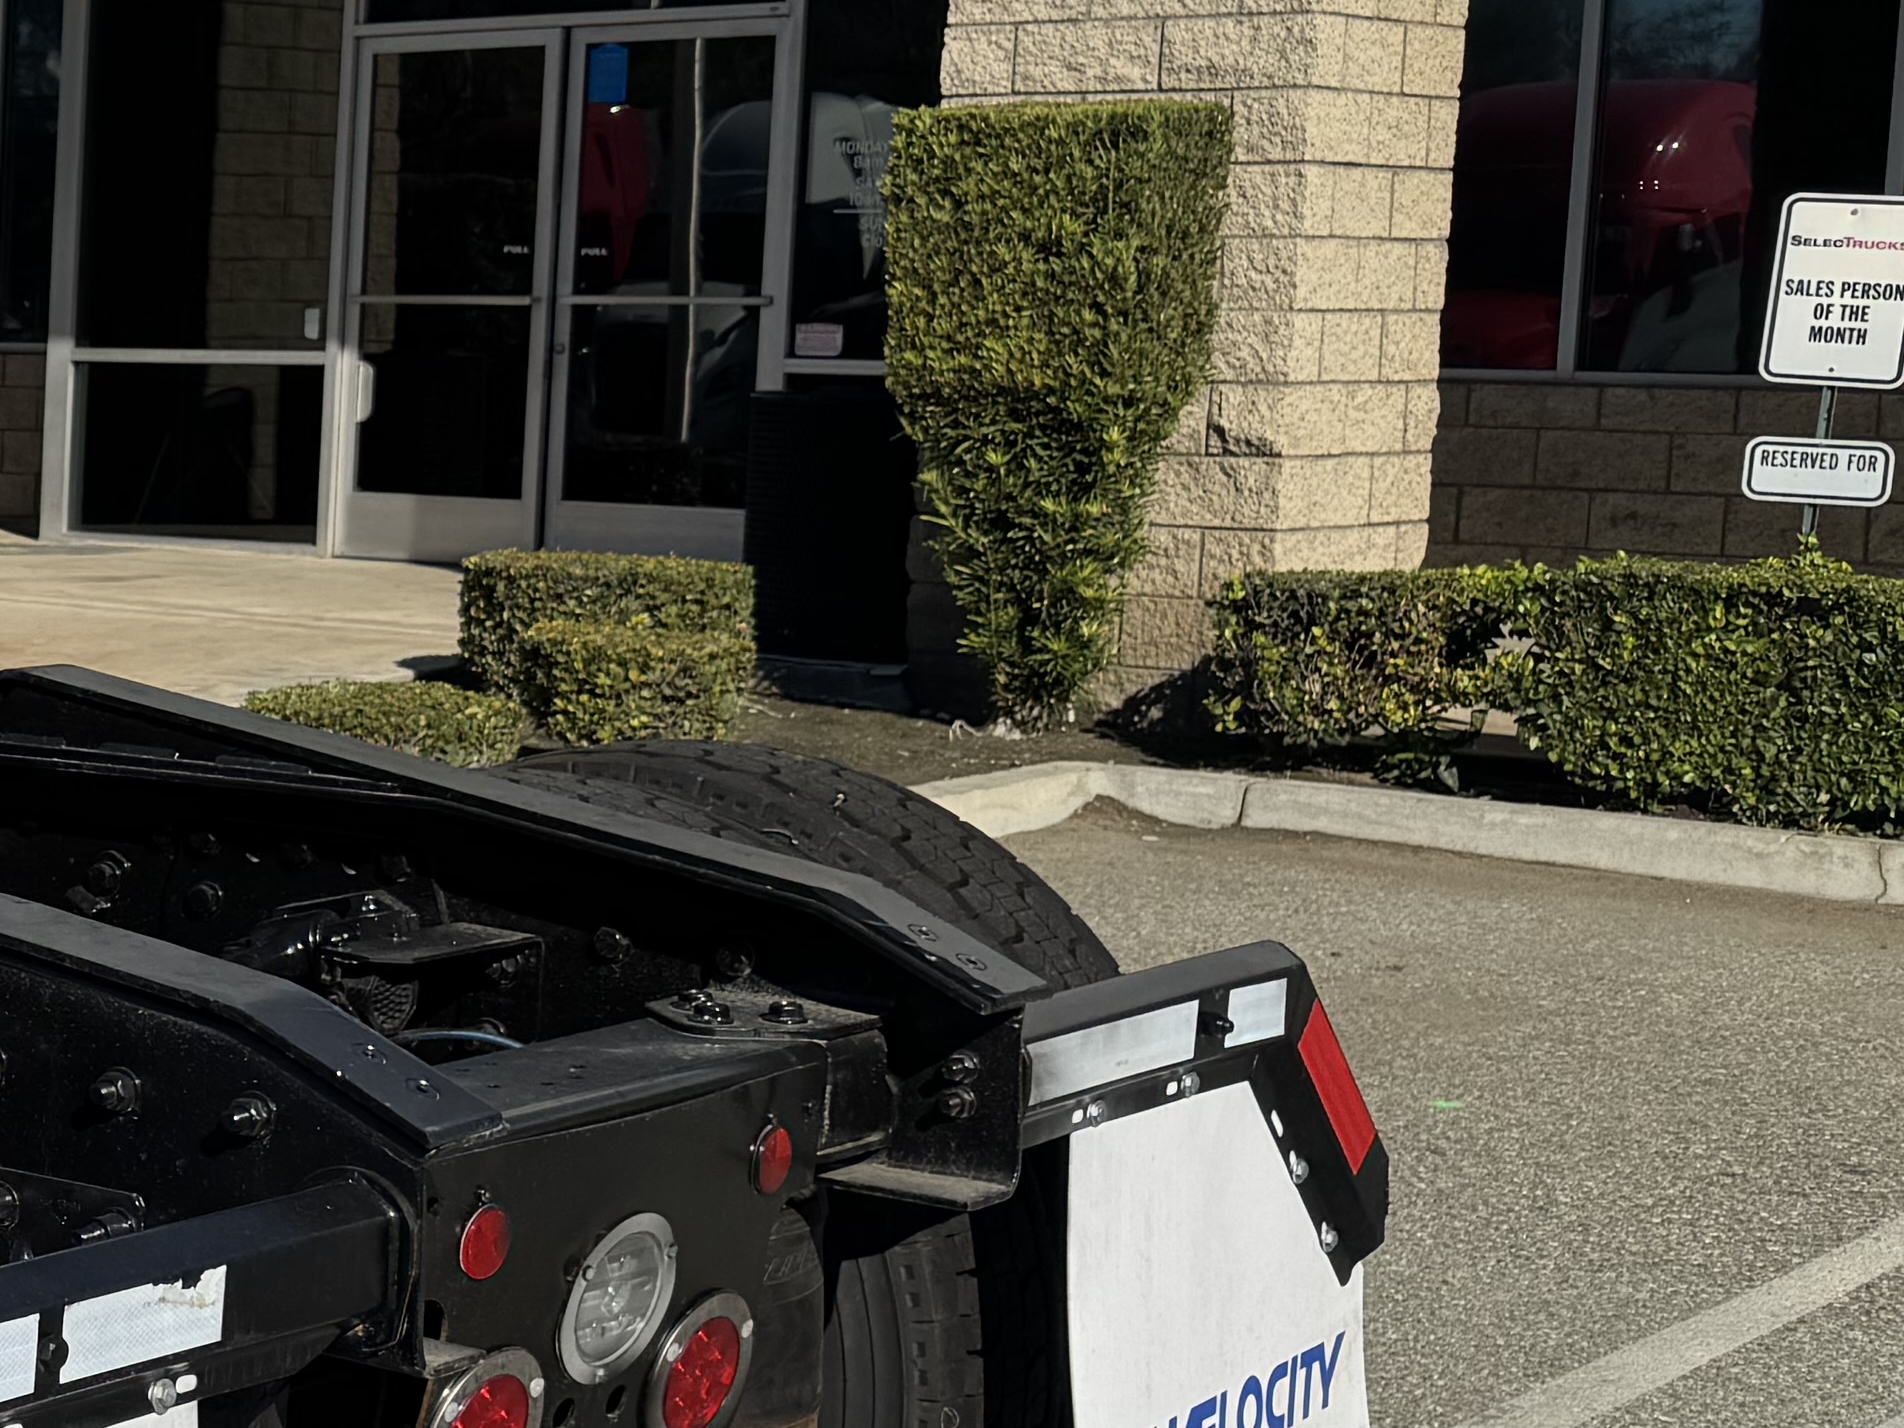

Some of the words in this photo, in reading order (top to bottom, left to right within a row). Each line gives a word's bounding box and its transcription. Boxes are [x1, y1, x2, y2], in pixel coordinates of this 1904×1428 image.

[1785, 279, 1834, 298] SALES
[1840, 281, 1904, 301] PERSON
[1813, 303, 1835, 320] OF
[1840, 304, 1870, 322] THE
[1809, 326, 1867, 345] MONTH
[1760, 449, 1839, 470] RESERVED
[1847, 454, 1878, 472] FOR
